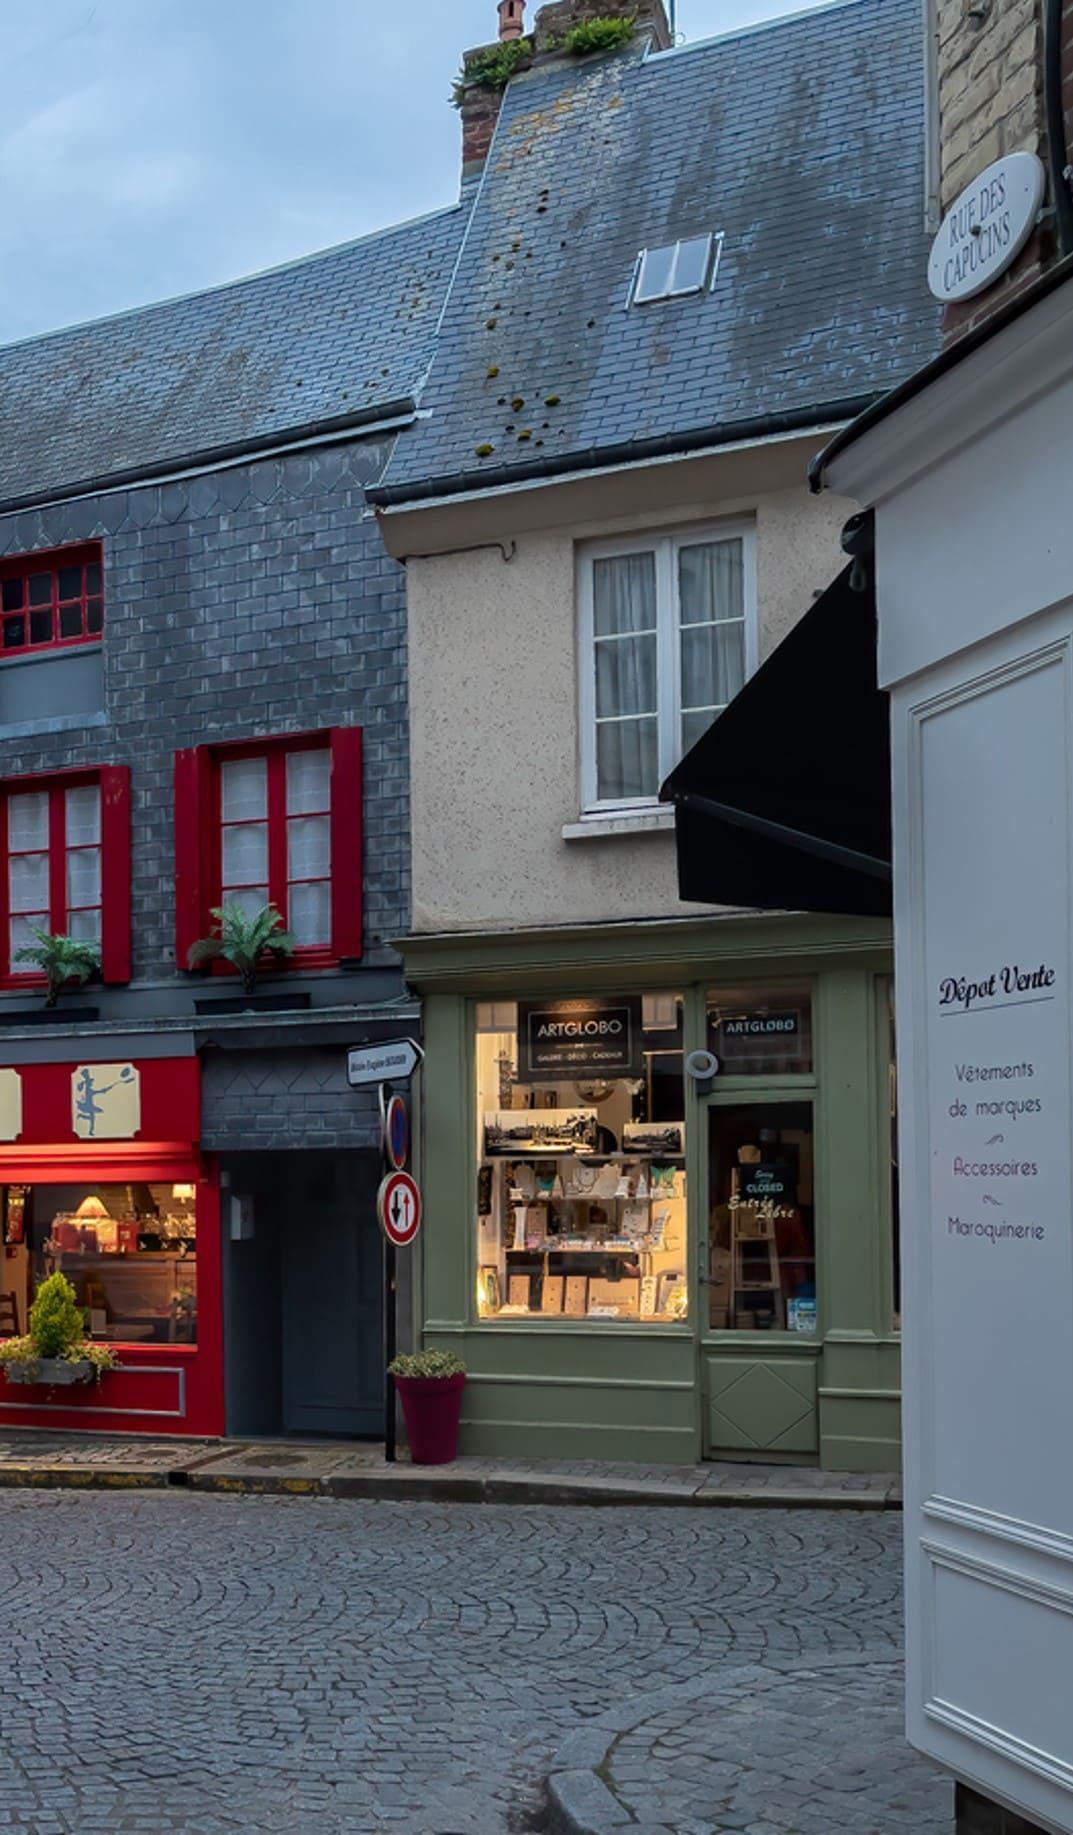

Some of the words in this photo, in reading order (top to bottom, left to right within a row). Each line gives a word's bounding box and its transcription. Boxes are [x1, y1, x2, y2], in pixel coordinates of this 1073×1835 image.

[949, 197, 976, 247] RUE
[980, 172, 1006, 221] DES
[943, 211, 1010, 292] CAPUCINS
[1000, 964, 1056, 994] Vente
[537, 1020, 623, 1037] ARTGLOBO
[726, 1018, 795, 1033] ARTGLOBO
[955, 1061, 1034, 1082] Vêtements
[948, 1098, 967, 1117] de
[976, 1097, 1042, 1120] marques
[953, 1156, 1039, 1176] Accessoires
[746, 1182, 784, 1193] CLOSED
[728, 1195, 774, 1210] Entrée
[948, 1216, 1045, 1244] Maroquinerie
